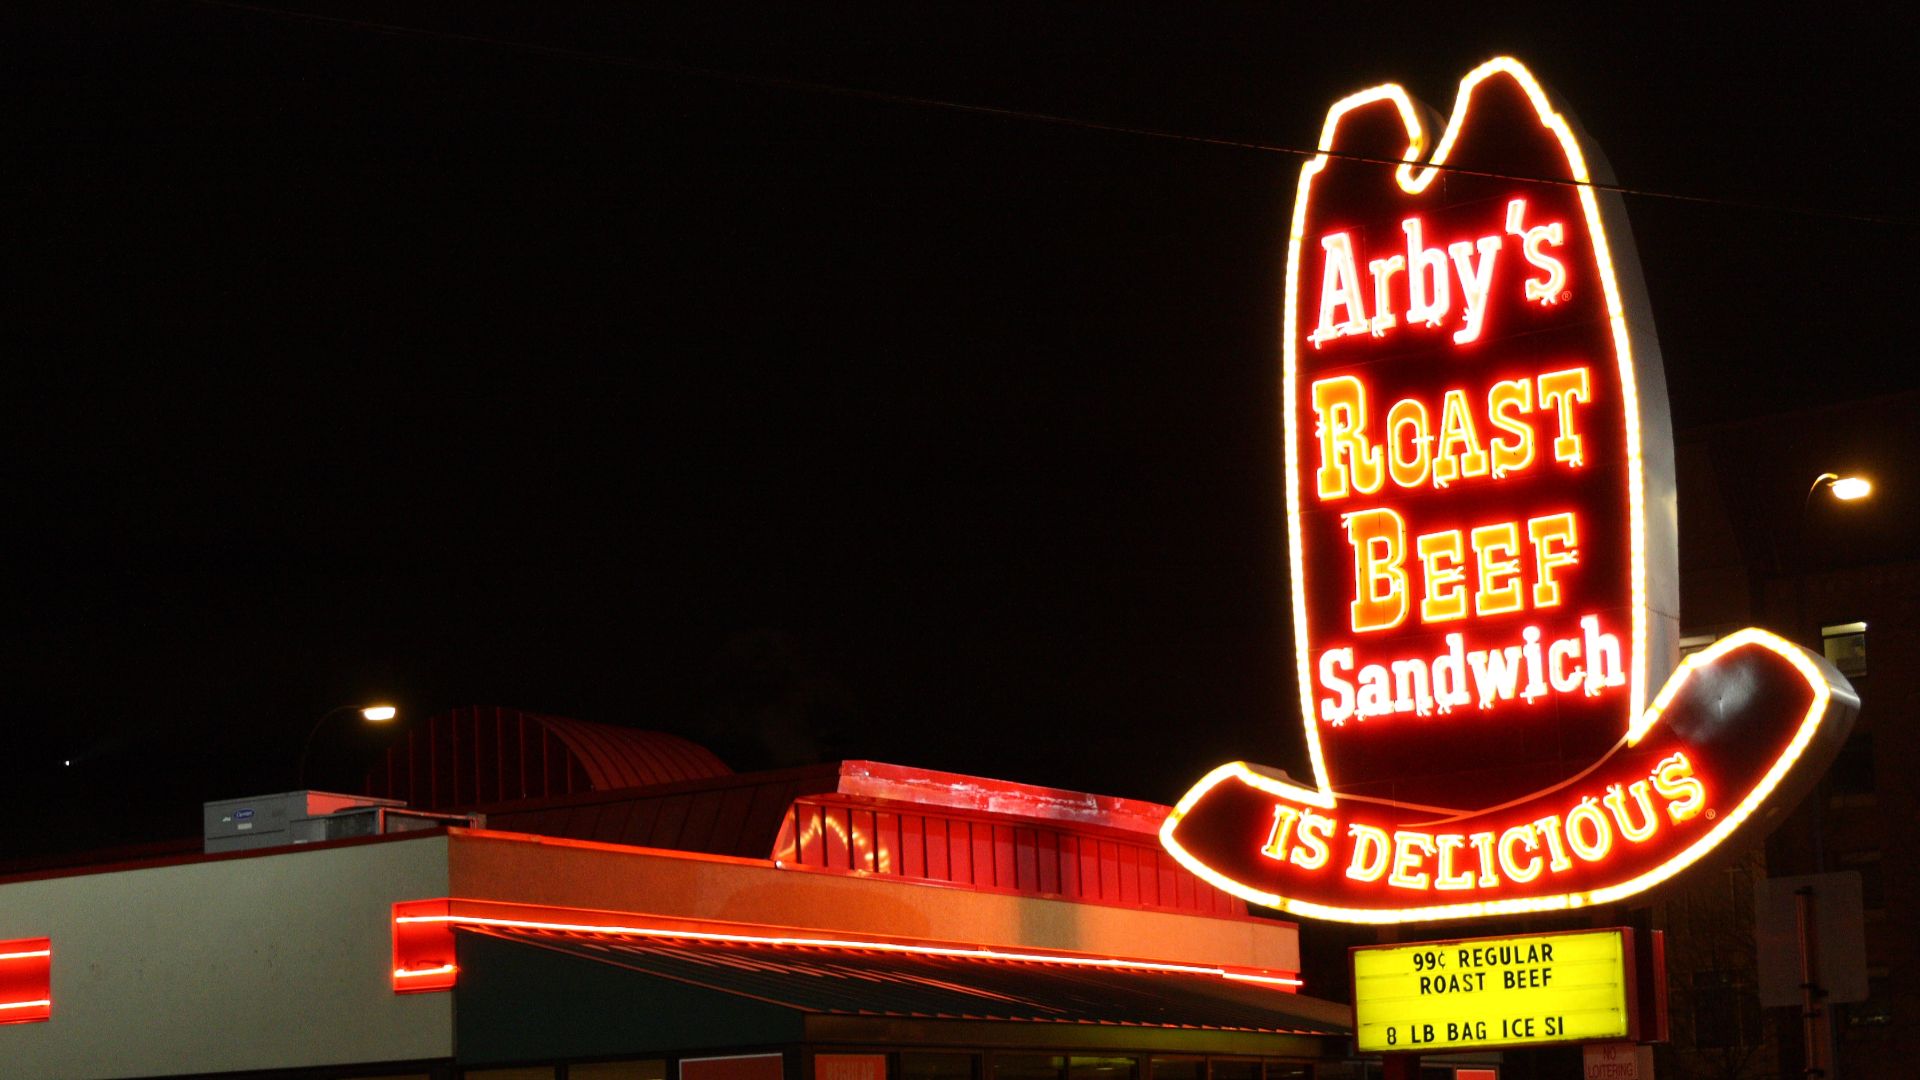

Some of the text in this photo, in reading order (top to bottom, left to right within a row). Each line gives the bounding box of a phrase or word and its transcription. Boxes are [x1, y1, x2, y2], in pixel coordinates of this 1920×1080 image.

[1308, 198, 1568, 346] Arby's
[1311, 366, 1591, 501] ROAST
[1345, 507, 1578, 633] BEEF
[1318, 614, 1626, 724] Sandwich
[1261, 752, 1707, 890] IS DELICIOUS
[1413, 943, 1554, 972] 99¢ REGULAR
[1420, 968, 1552, 995] ROAST BEEF
[1386, 1016, 1564, 1046] 8 LB BAG ICE SI
[1602, 1046, 1617, 1060] NO
